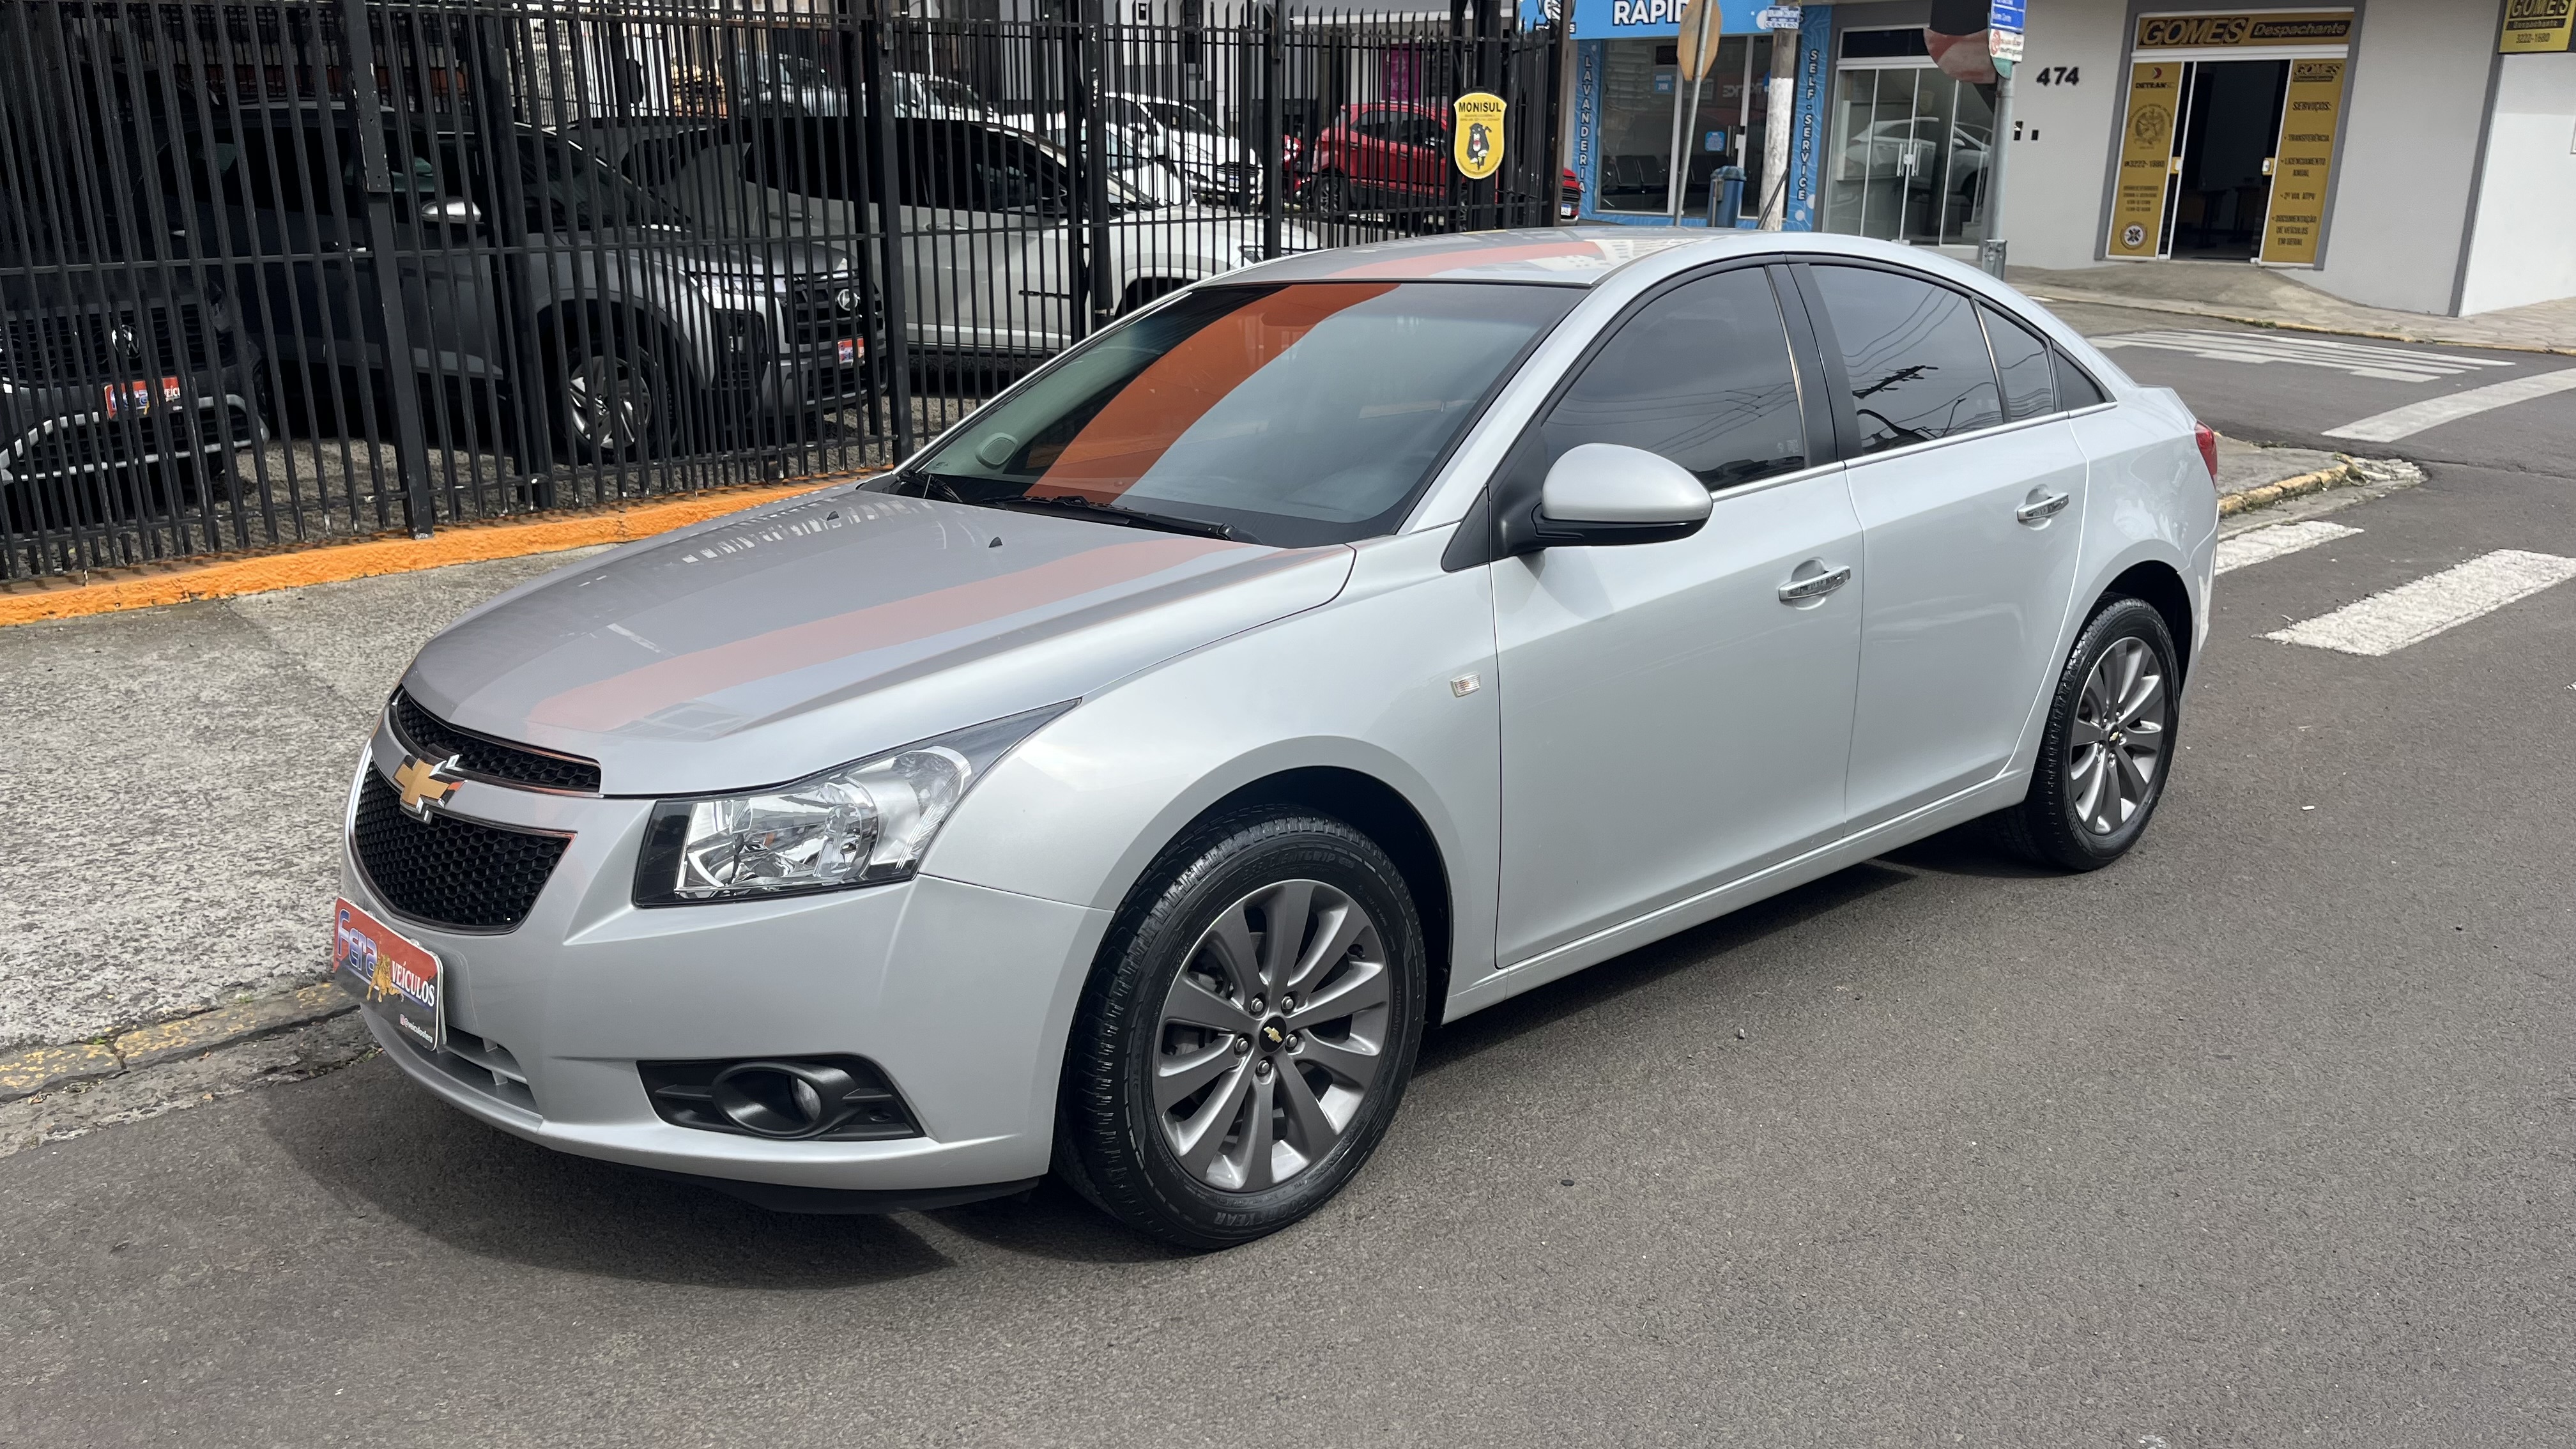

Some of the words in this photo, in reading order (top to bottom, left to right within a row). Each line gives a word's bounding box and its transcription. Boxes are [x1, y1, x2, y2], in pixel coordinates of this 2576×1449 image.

[2511, 0, 2569, 17] GOMES
[2142, 18, 2248, 45] GOMES
[2253, 22, 2347, 38] Despachante
[2036, 66, 2079, 86] 474
[1459, 102, 1501, 112] MONISUL
[1579, 55, 1592, 193] LAVANDERIA
[337, 908, 378, 979] Fera
[392, 960, 435, 1008] VEÍCULOS
